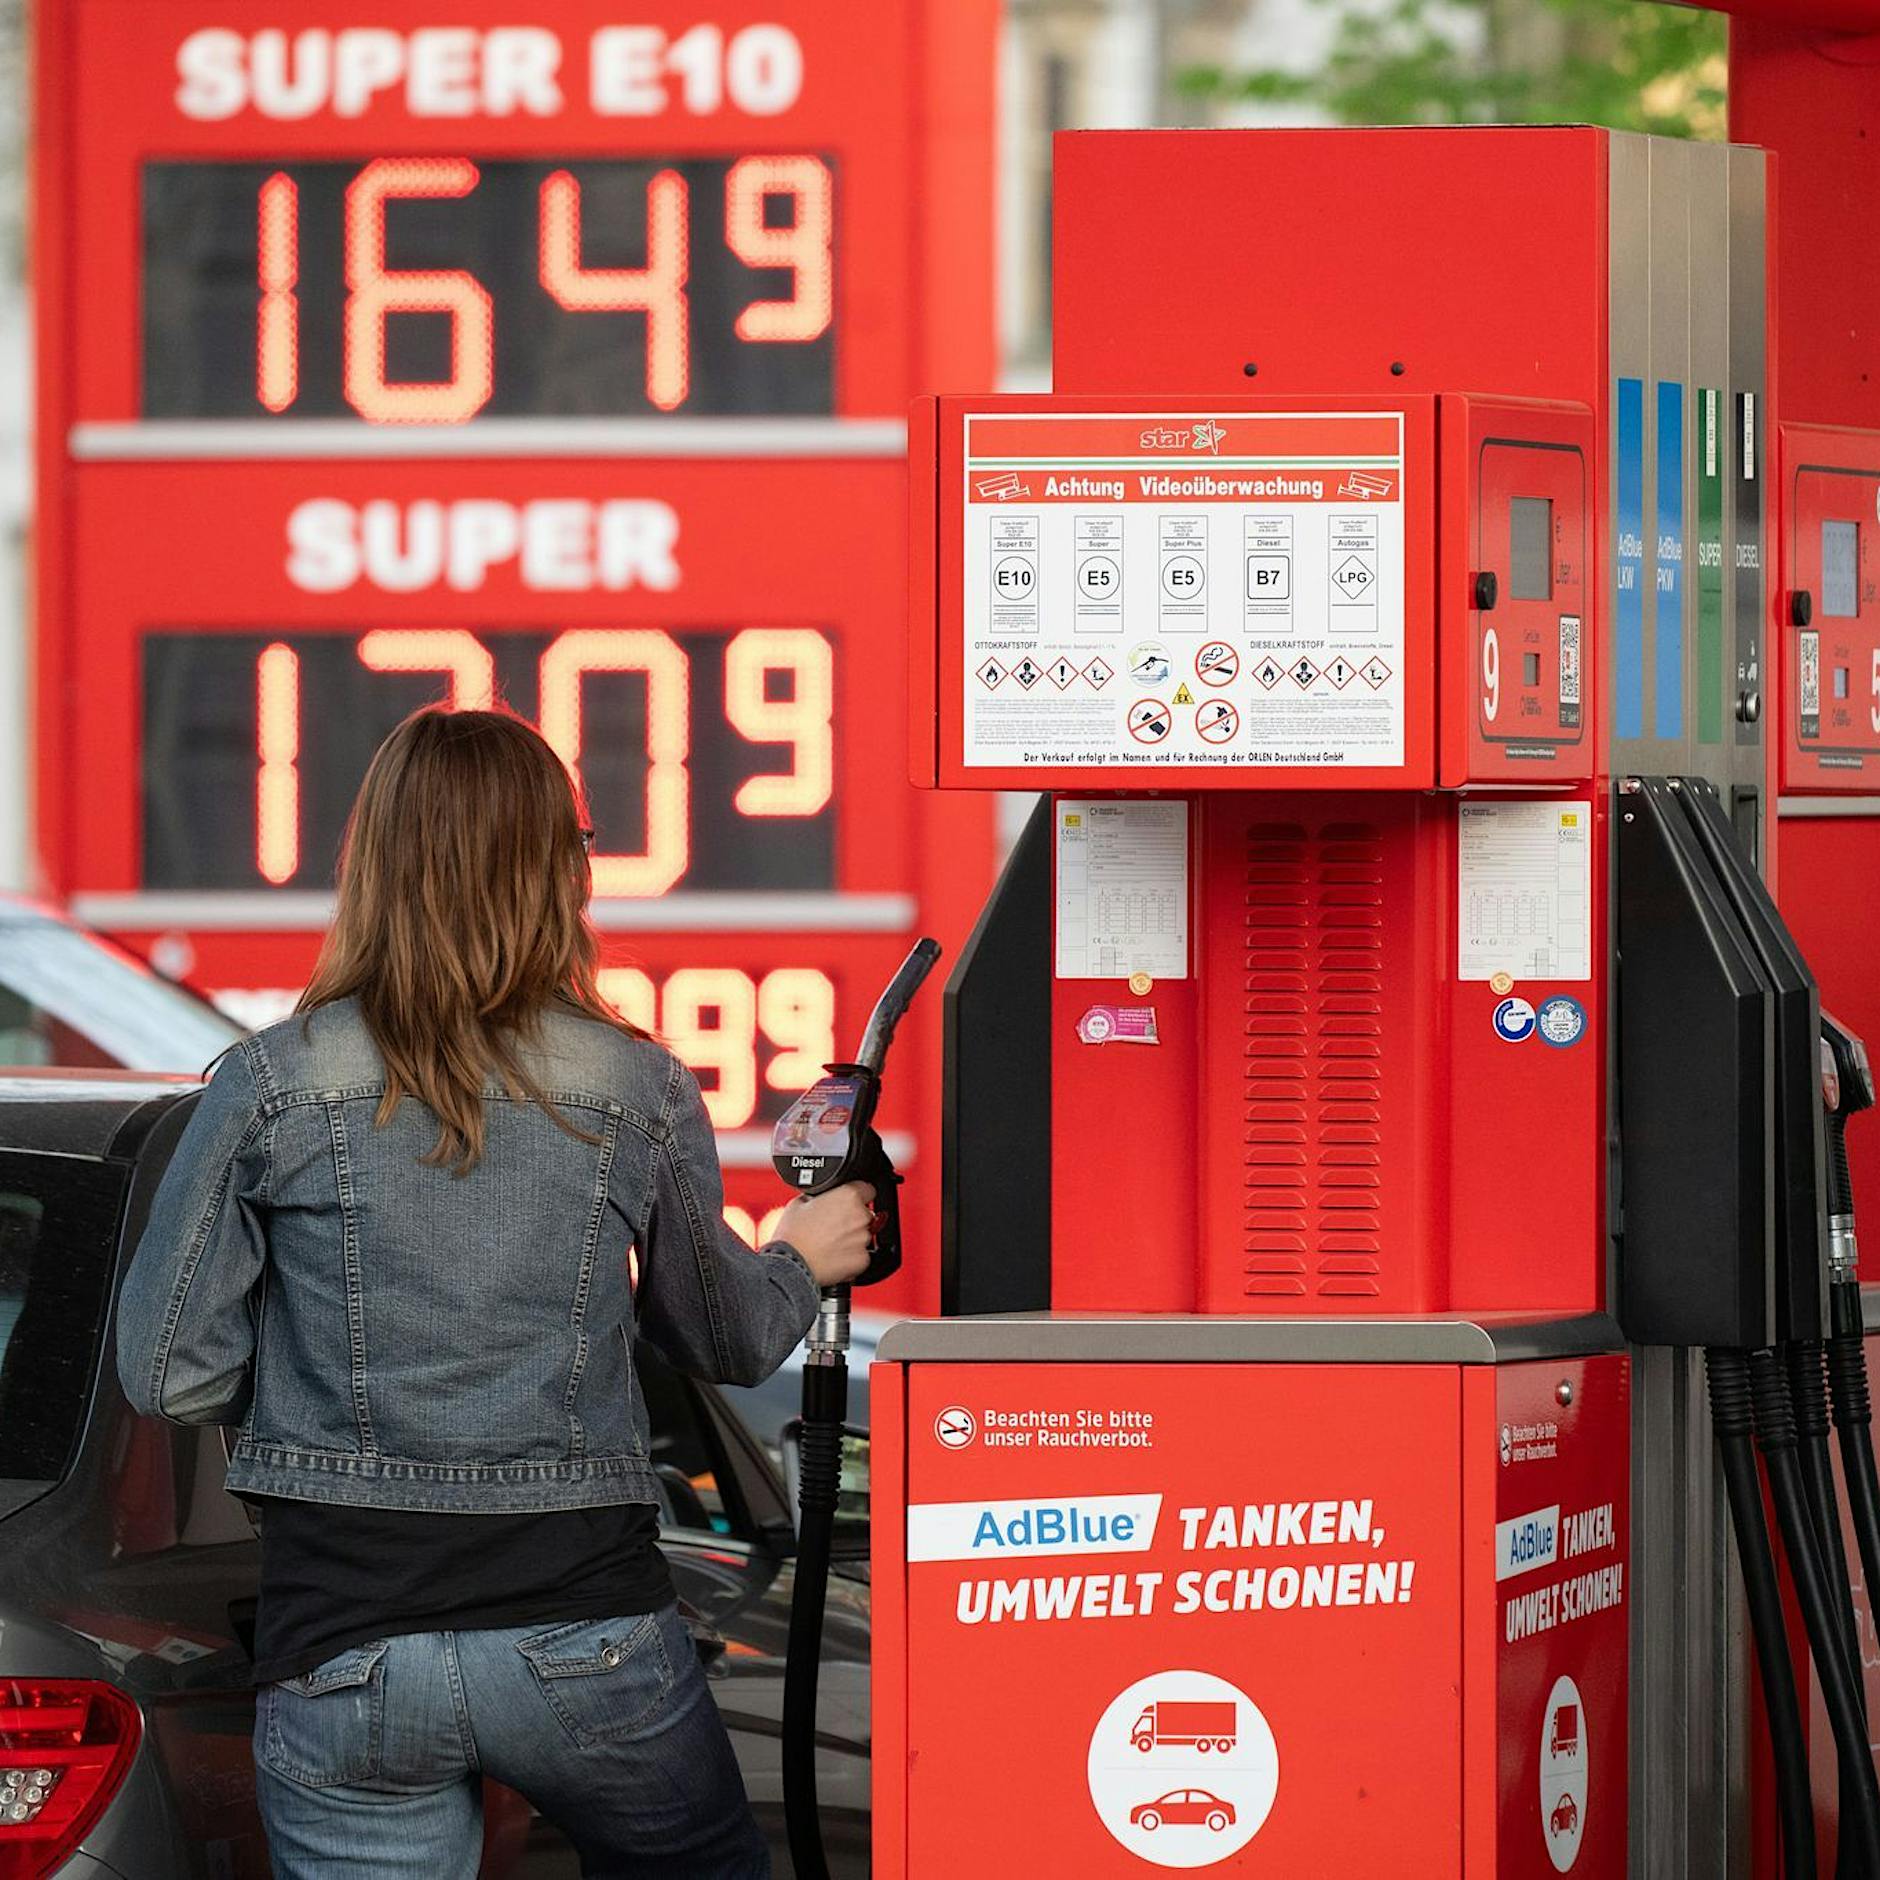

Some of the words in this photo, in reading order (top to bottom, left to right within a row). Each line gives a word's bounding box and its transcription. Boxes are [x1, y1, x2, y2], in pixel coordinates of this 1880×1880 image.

[175, 26, 564, 120] SUPER
[590, 23, 804, 117] E10
[1140, 427, 1190, 449] star
[1044, 476, 1125, 499] Achtung
[1139, 475, 1323, 499] Videoüberwachung
[286, 497, 682, 593] SUPER
[996, 541, 1018, 549] Super
[1088, 541, 1109, 549] Super
[1164, 540, 1185, 549] Super
[1186, 540, 1202, 548] Plus
[1256, 539, 1281, 547] Diesel
[1337, 539, 1369, 548] Autogas
[1617, 533, 1642, 559] AdBlue
[1656, 536, 1682, 561] AdBlue
[1698, 543, 1722, 567] SUPER
[1736, 545, 1760, 568] DIESEL
[998, 571, 1031, 586] E10
[1087, 570, 1110, 586] E5
[1171, 570, 1195, 586] E5
[1256, 570, 1281, 585] B7
[1339, 572, 1367, 584] LPG
[1617, 566, 1635, 590] LKW
[1656, 568, 1675, 592] PKW
[974, 641, 1038, 650] OTTOKRAFTSTOFF
[1249, 640, 1325, 650] DIESELKRAFTSTOFF
[1482, 627, 1500, 722] 9
[1023, 752, 1038, 762] Der
[1042, 752, 1074, 762] Verkauf
[1077, 752, 1106, 763] erfolgt
[1109, 752, 1119, 762] im
[1122, 753, 1152, 762] Namen
[1155, 752, 1170, 762] und
[1173, 752, 1185, 762] für
[1189, 752, 1227, 763] Rechnung
[1231, 752, 1245, 762] der
[1248, 752, 1273, 762] ORLEN
[1275, 752, 1321, 762] Deutschland
[1323, 752, 1344, 762] GmbH
[791, 1156, 825, 1168] Diesel
[984, 1409, 1070, 1428] Beachten
[1076, 1409, 1103, 1428] Sie
[1109, 1409, 1153, 1428] bitte
[984, 1431, 1032, 1448] unser
[1037, 1429, 1153, 1448] Rauchverbot.
[1513, 1426, 1536, 1443] Beachten
[1537, 1424, 1545, 1439] Sie
[1545, 1423, 1557, 1439] bitte
[1513, 1447, 1526, 1461] unser
[1178, 1498, 1386, 1550] TANKEN,
[1510, 1522, 1554, 1566] AdBlue
[1562, 1503, 1616, 1561] TANKEN,
[955, 1572, 1162, 1625] UMWELT
[1172, 1560, 1416, 1615] SCHONEN!
[1505, 1584, 1560, 1643] UMWELT
[1560, 1563, 1623, 1623] SCHONEN!
